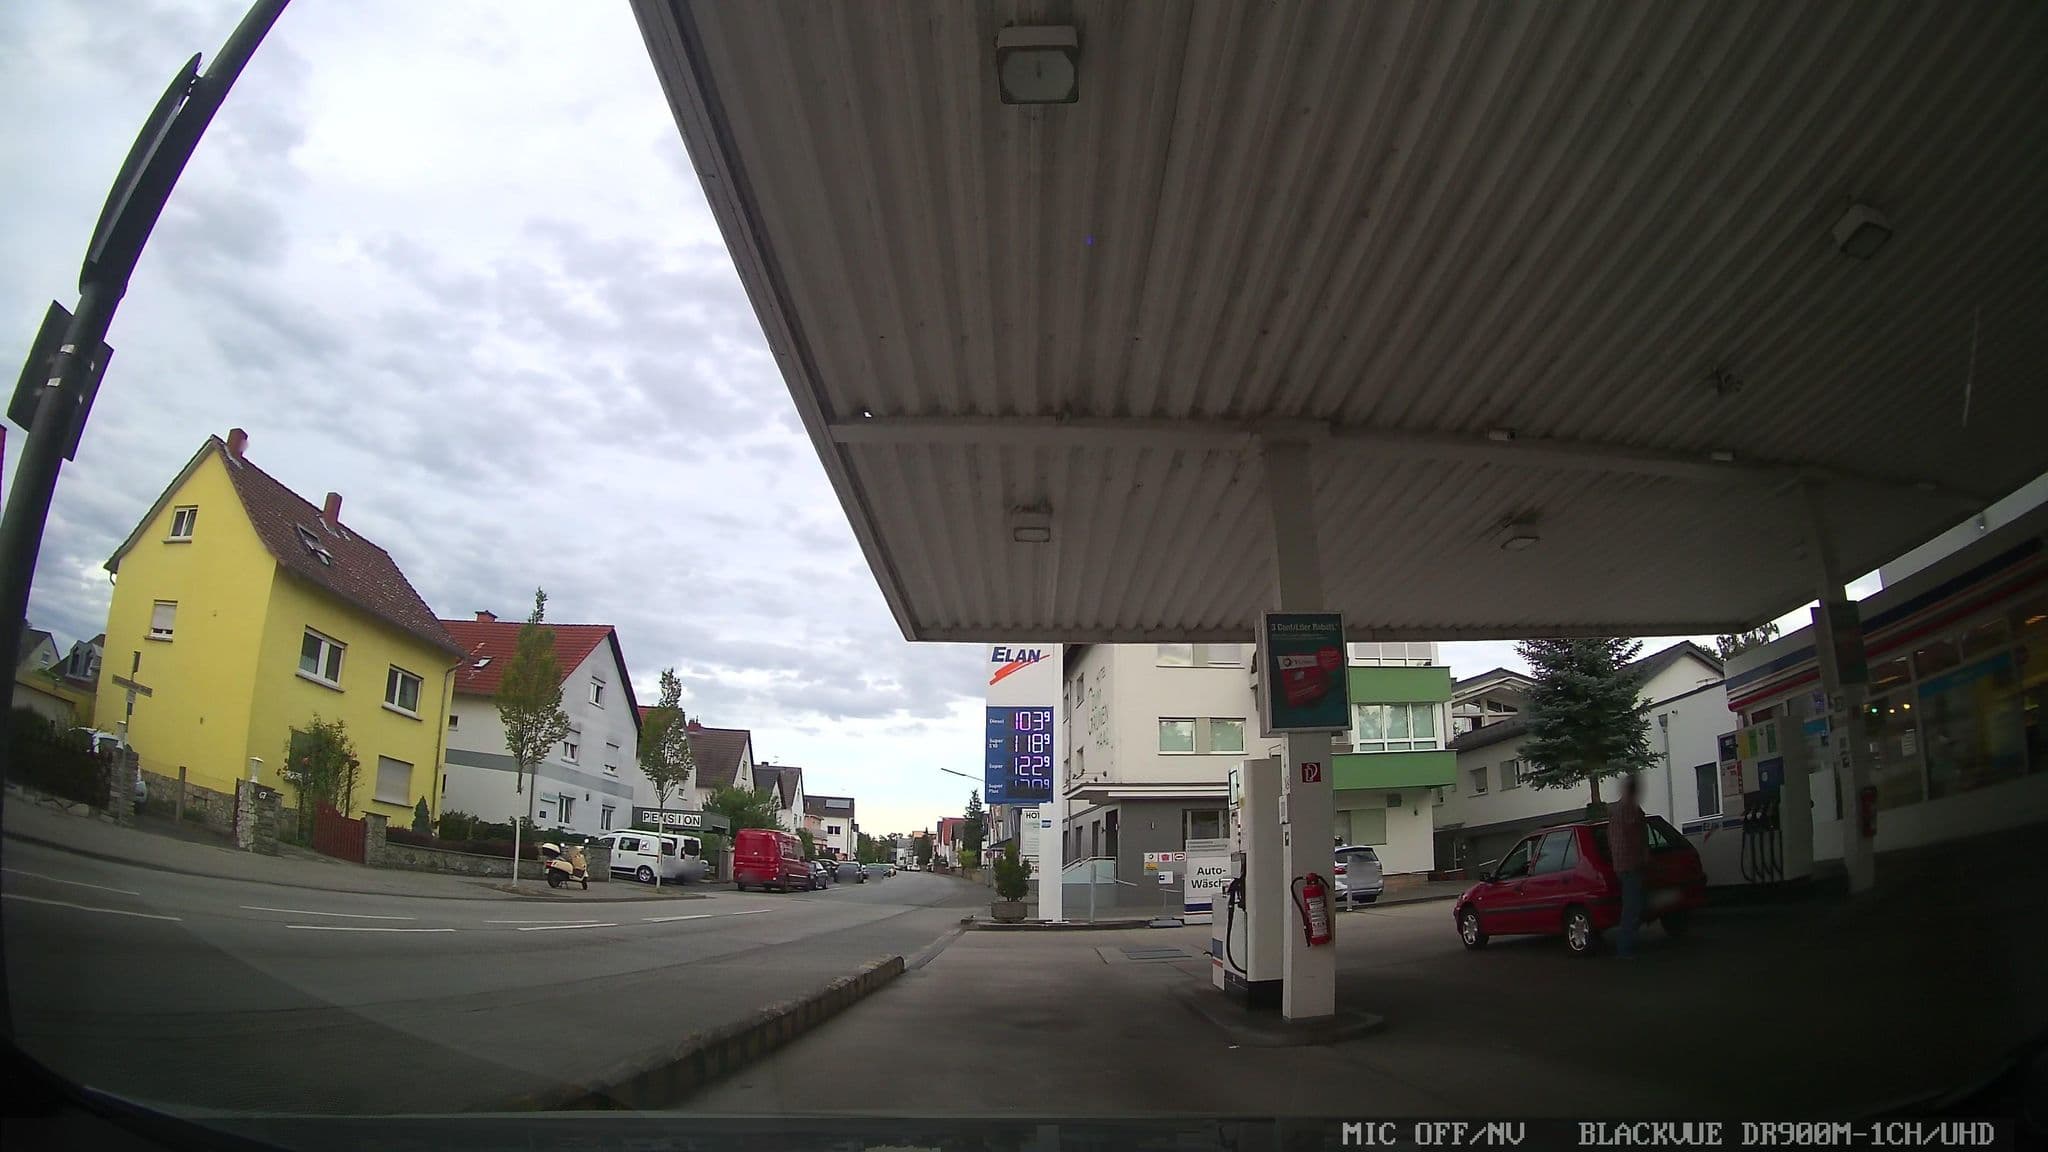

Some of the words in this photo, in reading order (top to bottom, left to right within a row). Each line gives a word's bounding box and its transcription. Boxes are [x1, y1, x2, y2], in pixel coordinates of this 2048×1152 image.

[991, 646, 1041, 663] ELAN
[643, 812, 701, 826] PENSION
[1196, 866, 1227, 876] Auto-
